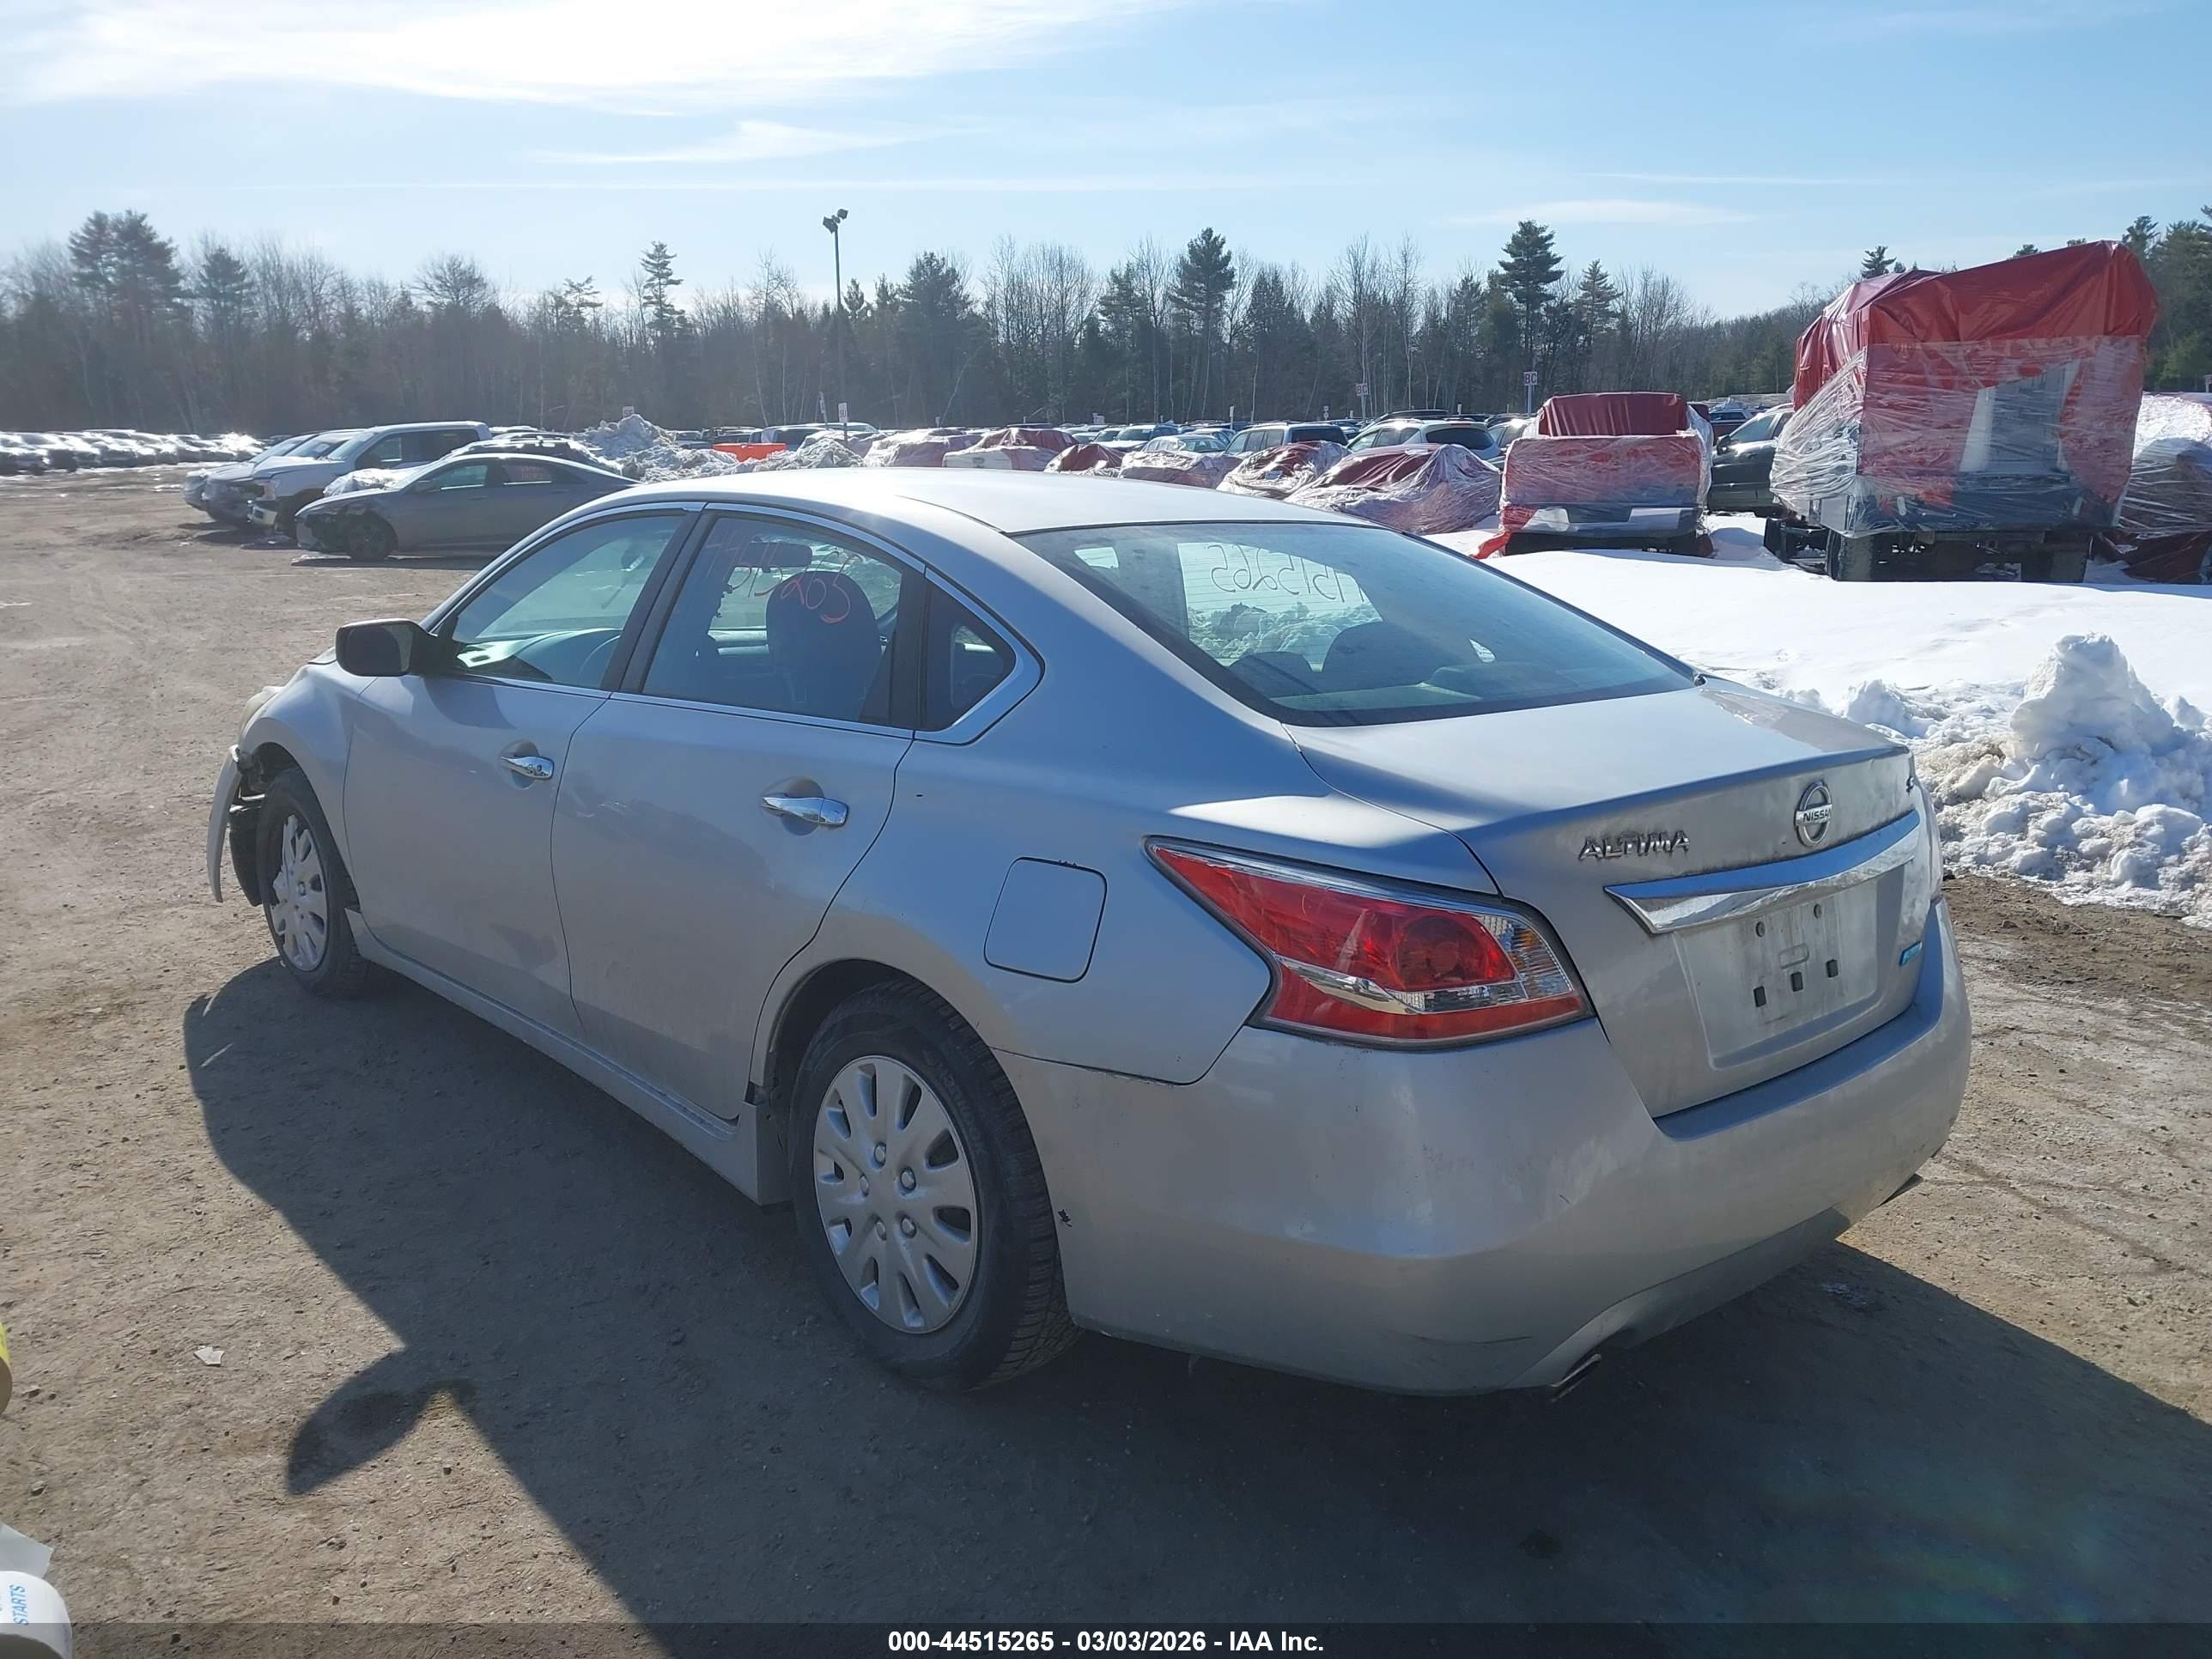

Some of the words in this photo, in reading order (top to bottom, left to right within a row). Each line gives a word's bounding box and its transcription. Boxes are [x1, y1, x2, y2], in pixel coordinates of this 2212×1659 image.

[1525, 373, 1537, 384] BC
[1578, 829, 1690, 861] ALTIMA
[9, 1583, 29, 1626] STARTS
